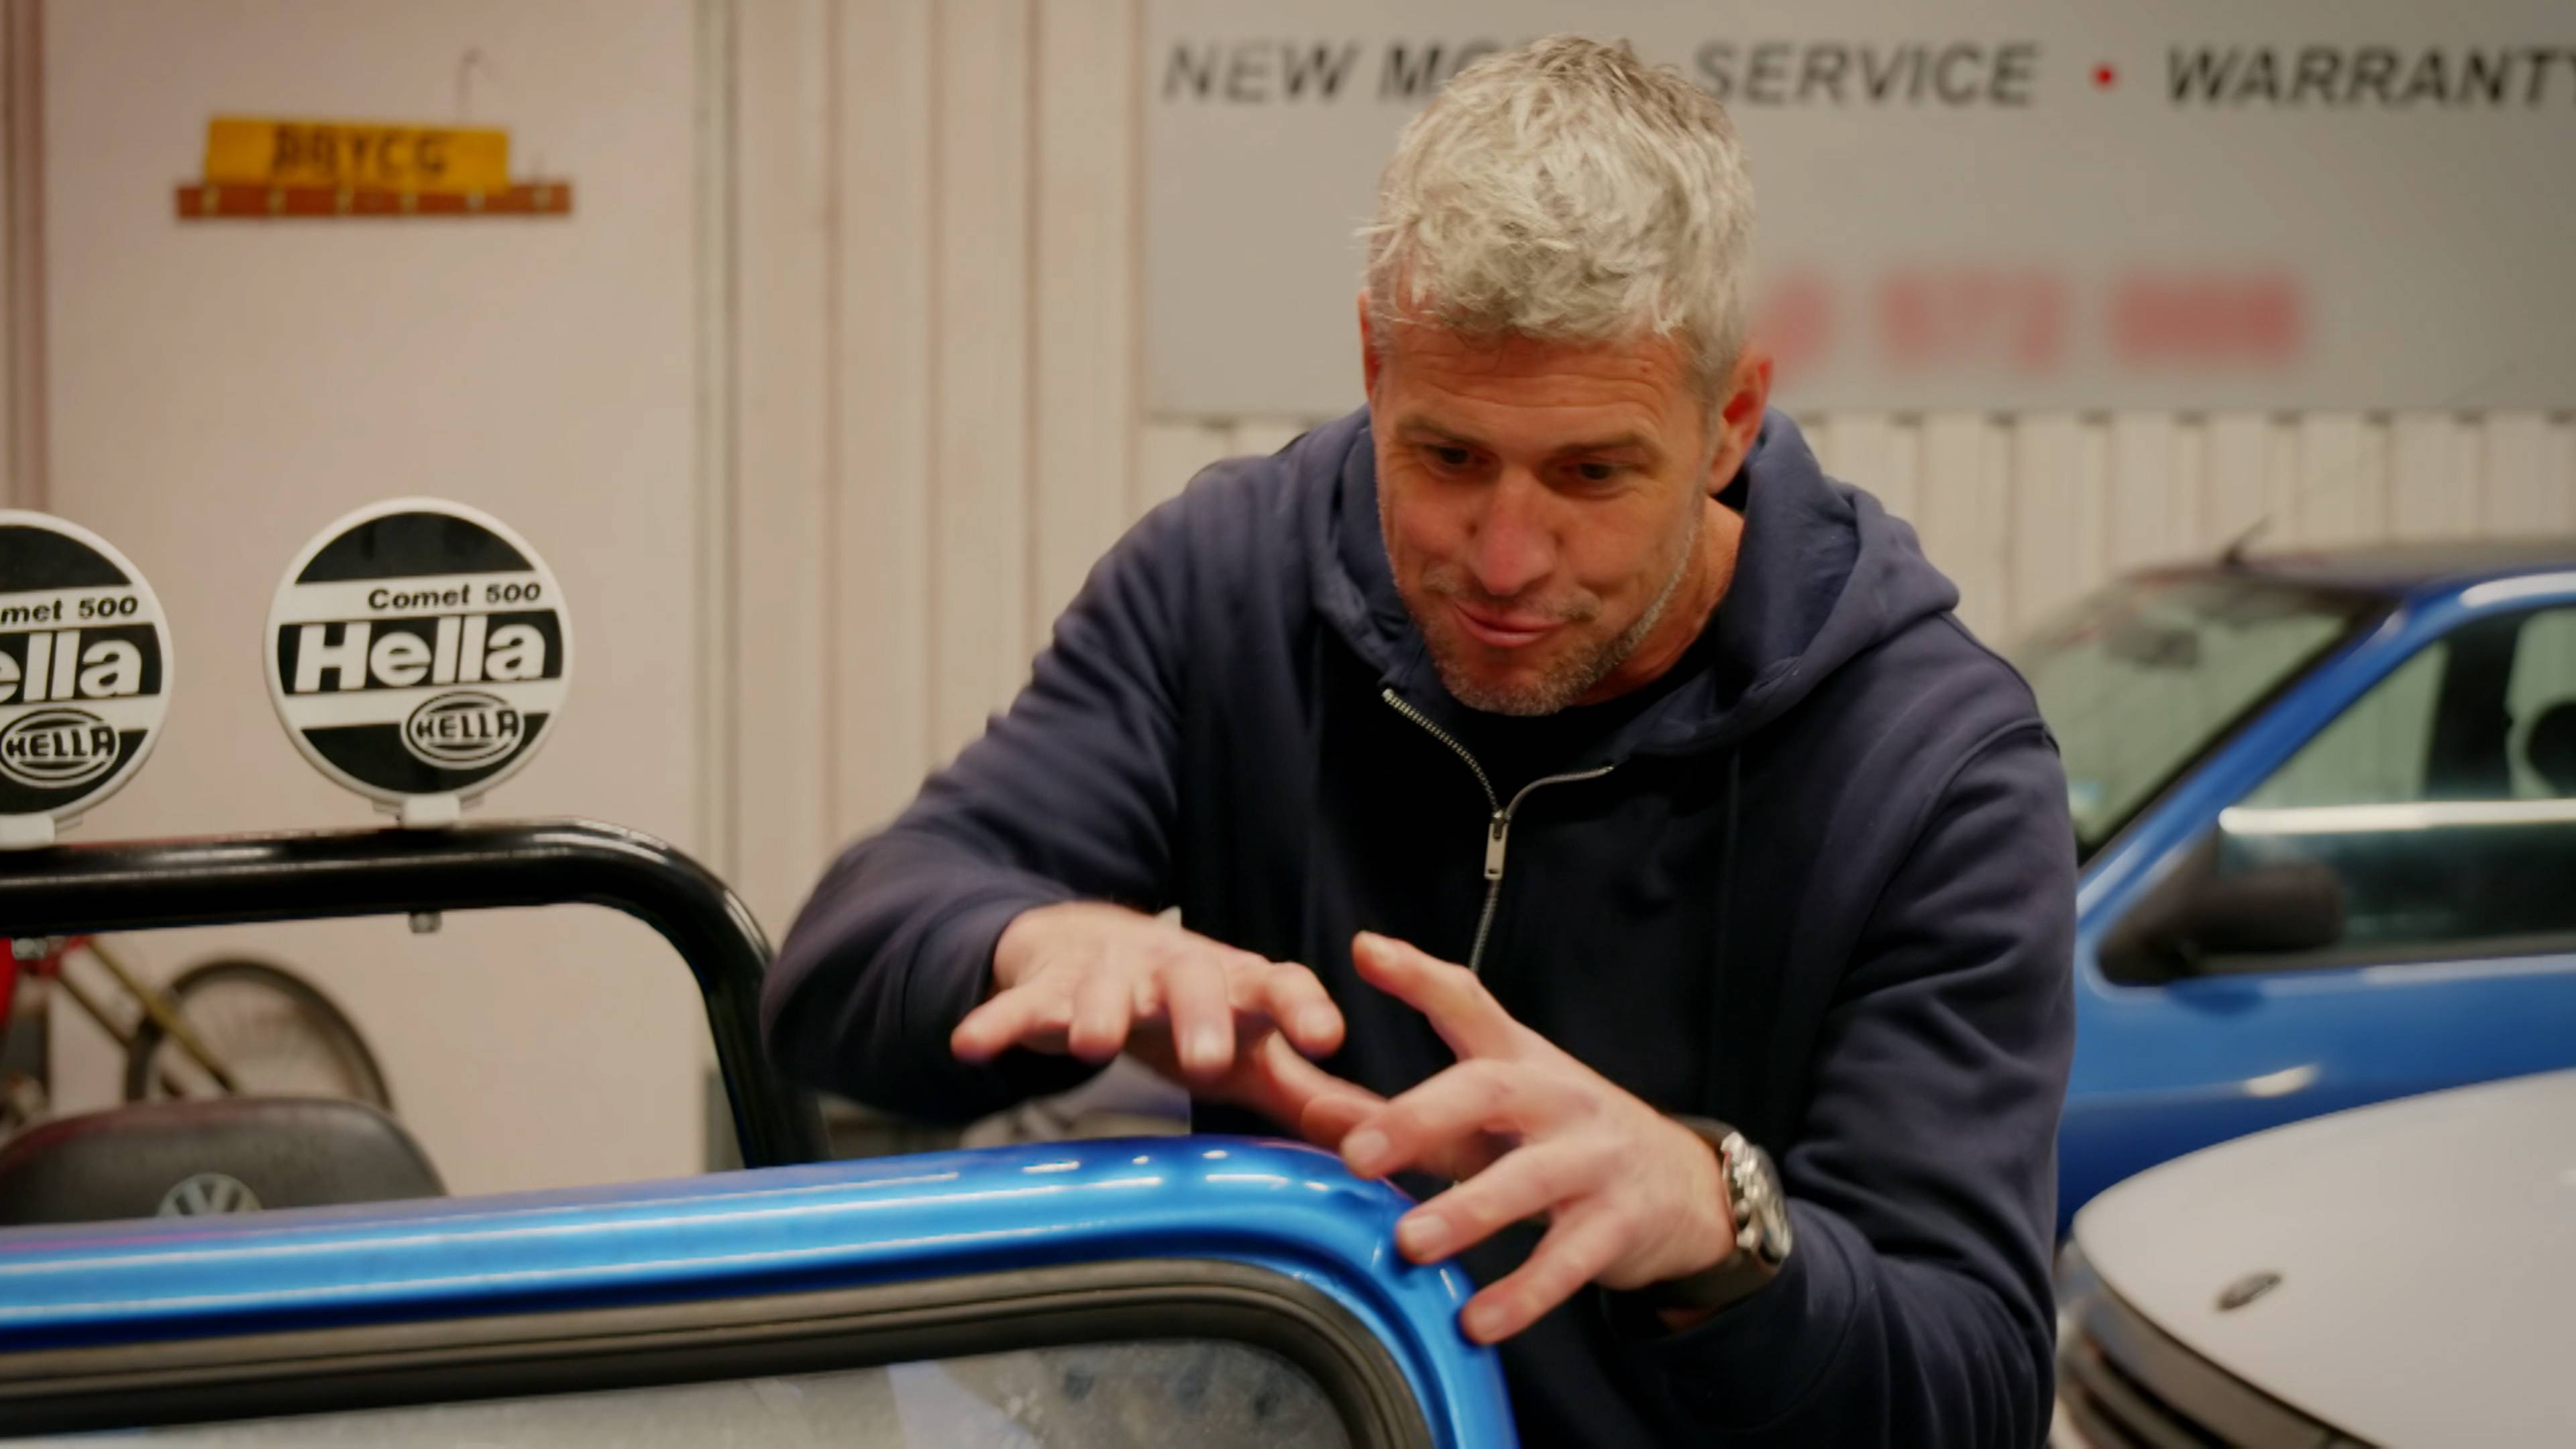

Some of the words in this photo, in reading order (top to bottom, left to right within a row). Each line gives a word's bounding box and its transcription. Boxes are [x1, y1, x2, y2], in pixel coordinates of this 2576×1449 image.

[1162, 40, 1360, 105] NEW
[1693, 42, 2039, 107] SERVICE
[2165, 43, 2576, 109] WARRANT
[78, 596, 138, 618] 500
[368, 585, 471, 611] Comet
[486, 582, 541, 602] 500
[295, 616, 546, 692] Hella
[415, 708, 519, 741] HELLA
[6, 726, 117, 758] HELLA
